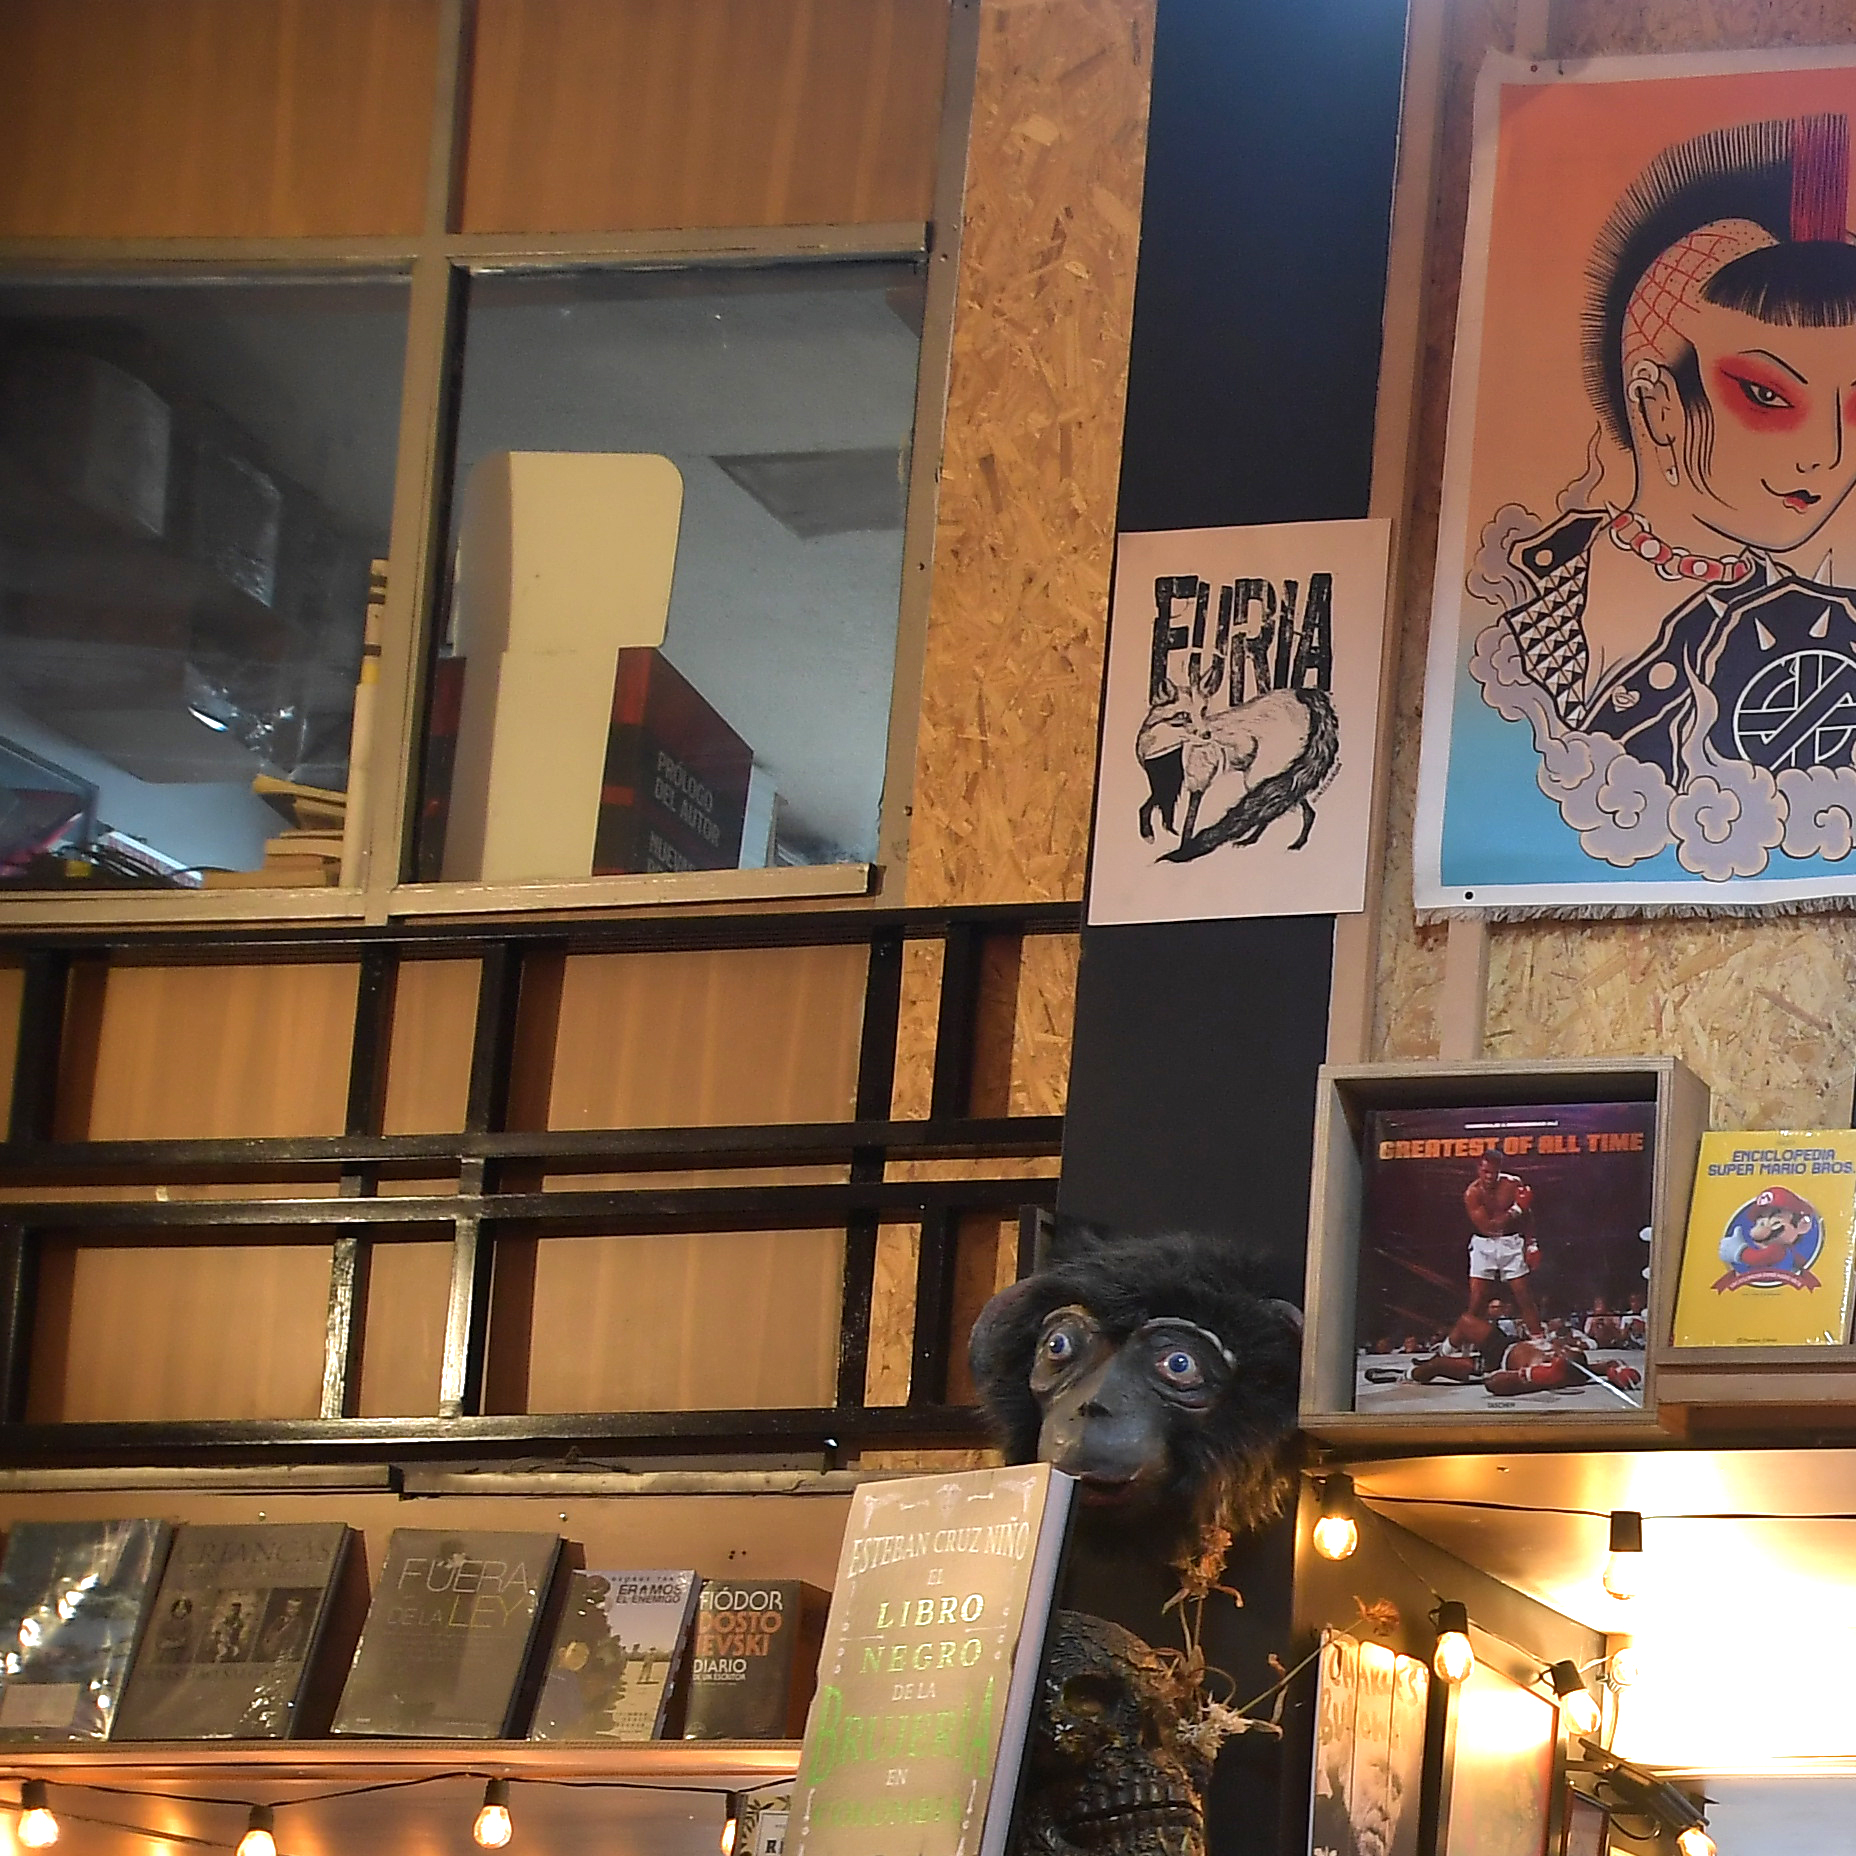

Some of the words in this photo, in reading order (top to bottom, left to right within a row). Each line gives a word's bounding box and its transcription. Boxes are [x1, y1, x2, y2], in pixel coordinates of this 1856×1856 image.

[1146, 573, 1334, 705] FURIA
[1379, 1135, 1499, 1161] GREATEST
[1503, 1134, 1533, 1157] OF
[1539, 1133, 1582, 1155] ALL
[1587, 1130, 1645, 1153] TIME
[1732, 1147, 1836, 1165] ENCICLOPEDIA
[1707, 1161, 1756, 1178] SUPER
[1760, 1161, 1808, 1177] MARIO
[1811, 1160, 1856, 1176] BROS.
[846, 1531, 932, 1579] ESTEBAN
[932, 1526, 982, 1555] CRUZ
[983, 1516, 1031, 1562] NIÑO
[397, 1555, 535, 1594] FUERA
[447, 1595, 535, 1628] LEY
[631, 1594, 681, 1604] ENEMIGO
[699, 1585, 784, 1611] FIÓDOR
[876, 1593, 985, 1630] LIBRO
[697, 1610, 783, 1635] DOSTO
[692, 1658, 748, 1675] DIARIO
[859, 1638, 983, 1675] NEGRO
[891, 1683, 913, 1702] DE
[915, 1682, 936, 1700] LA
[885, 1768, 909, 1787] EN
[813, 1796, 963, 1827] COLOMBIA
